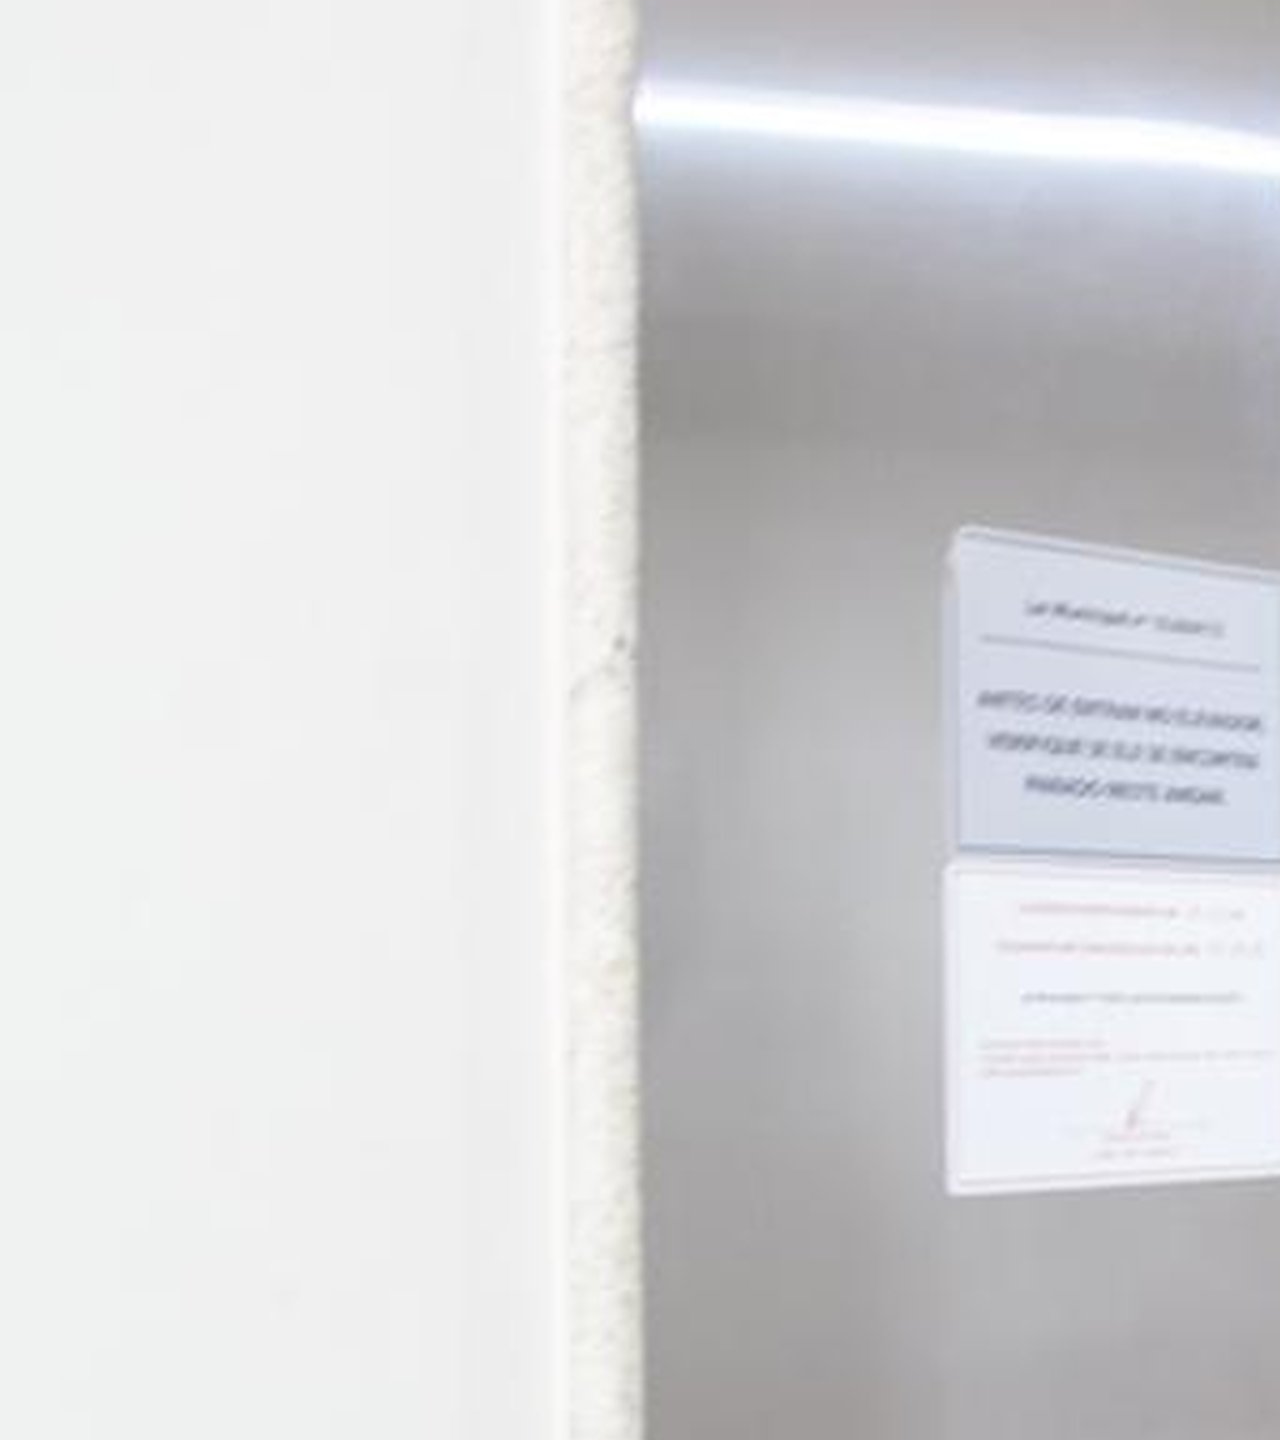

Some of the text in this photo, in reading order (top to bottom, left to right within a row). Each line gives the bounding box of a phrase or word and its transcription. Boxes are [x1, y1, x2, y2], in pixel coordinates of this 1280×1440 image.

[976, 688, 1039, 713] ANTES
[1042, 693, 1067, 716] DE
[1071, 696, 1139, 722] ENTRAR
[1143, 703, 1170, 725] NO
[987, 728, 1081, 756] VERIFIQUE
[1023, 771, 1099, 798] PARADO
[1104, 778, 1158, 802] NESTE
